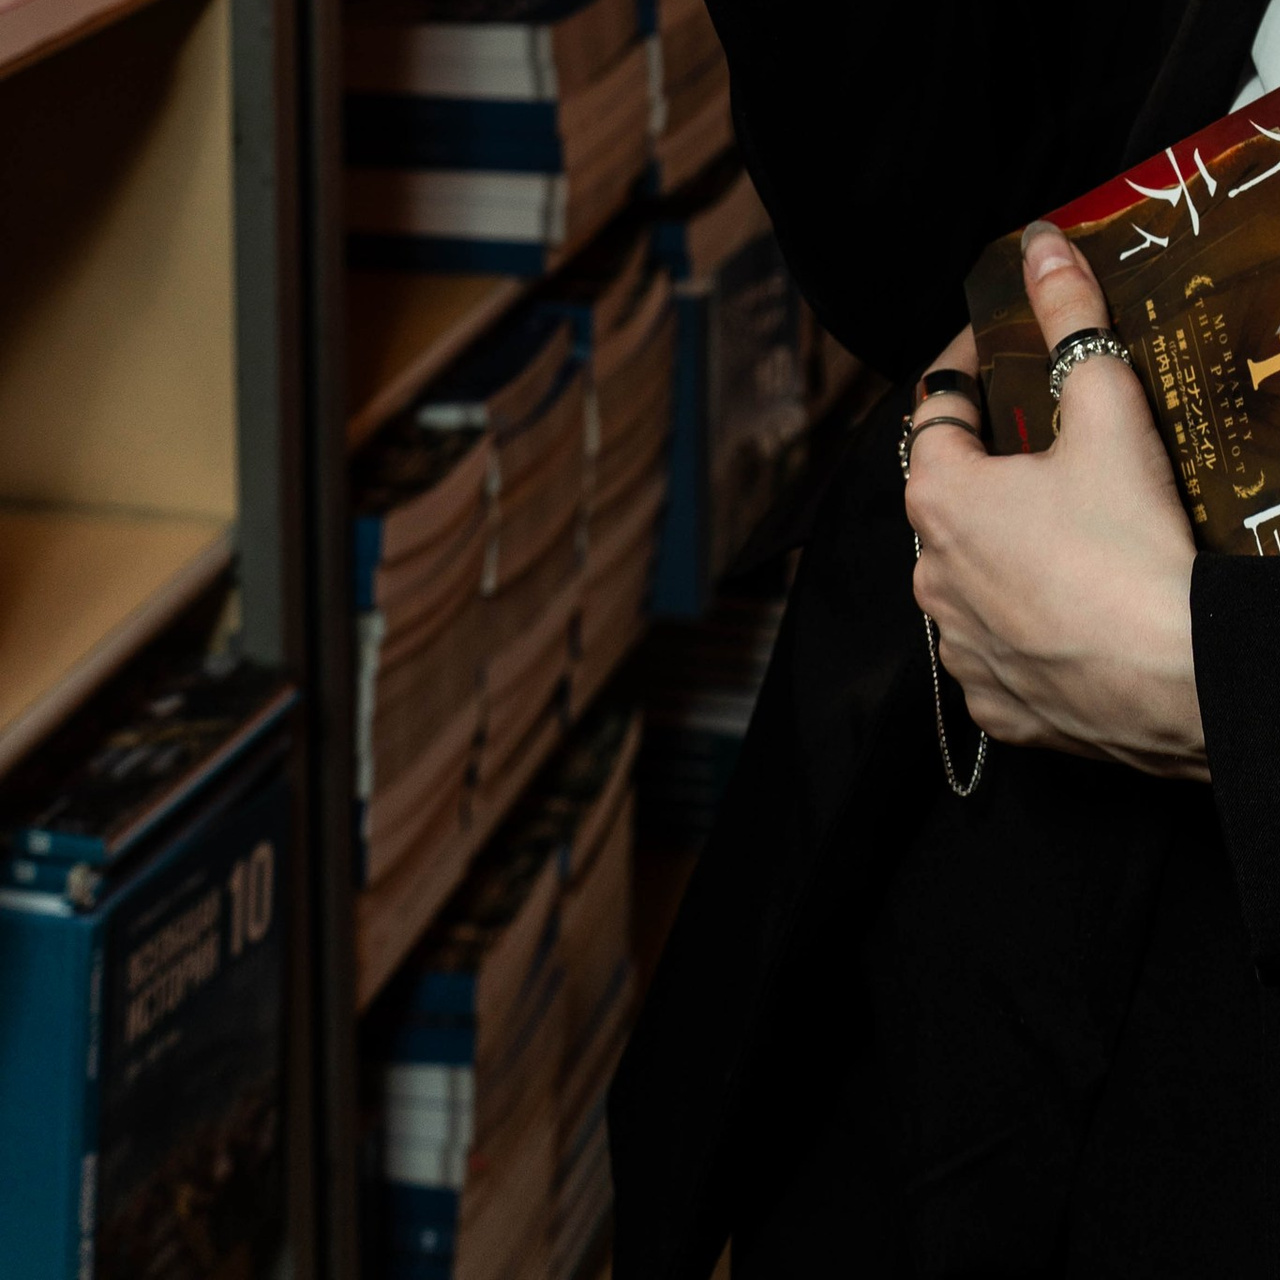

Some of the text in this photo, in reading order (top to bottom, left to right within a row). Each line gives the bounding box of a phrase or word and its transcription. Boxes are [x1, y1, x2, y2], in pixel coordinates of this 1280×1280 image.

[1195, 297, 1246, 474] THE PATRIOT
[1212, 313, 1253, 441] MORIARTY
[230, 842, 275, 956] 10
